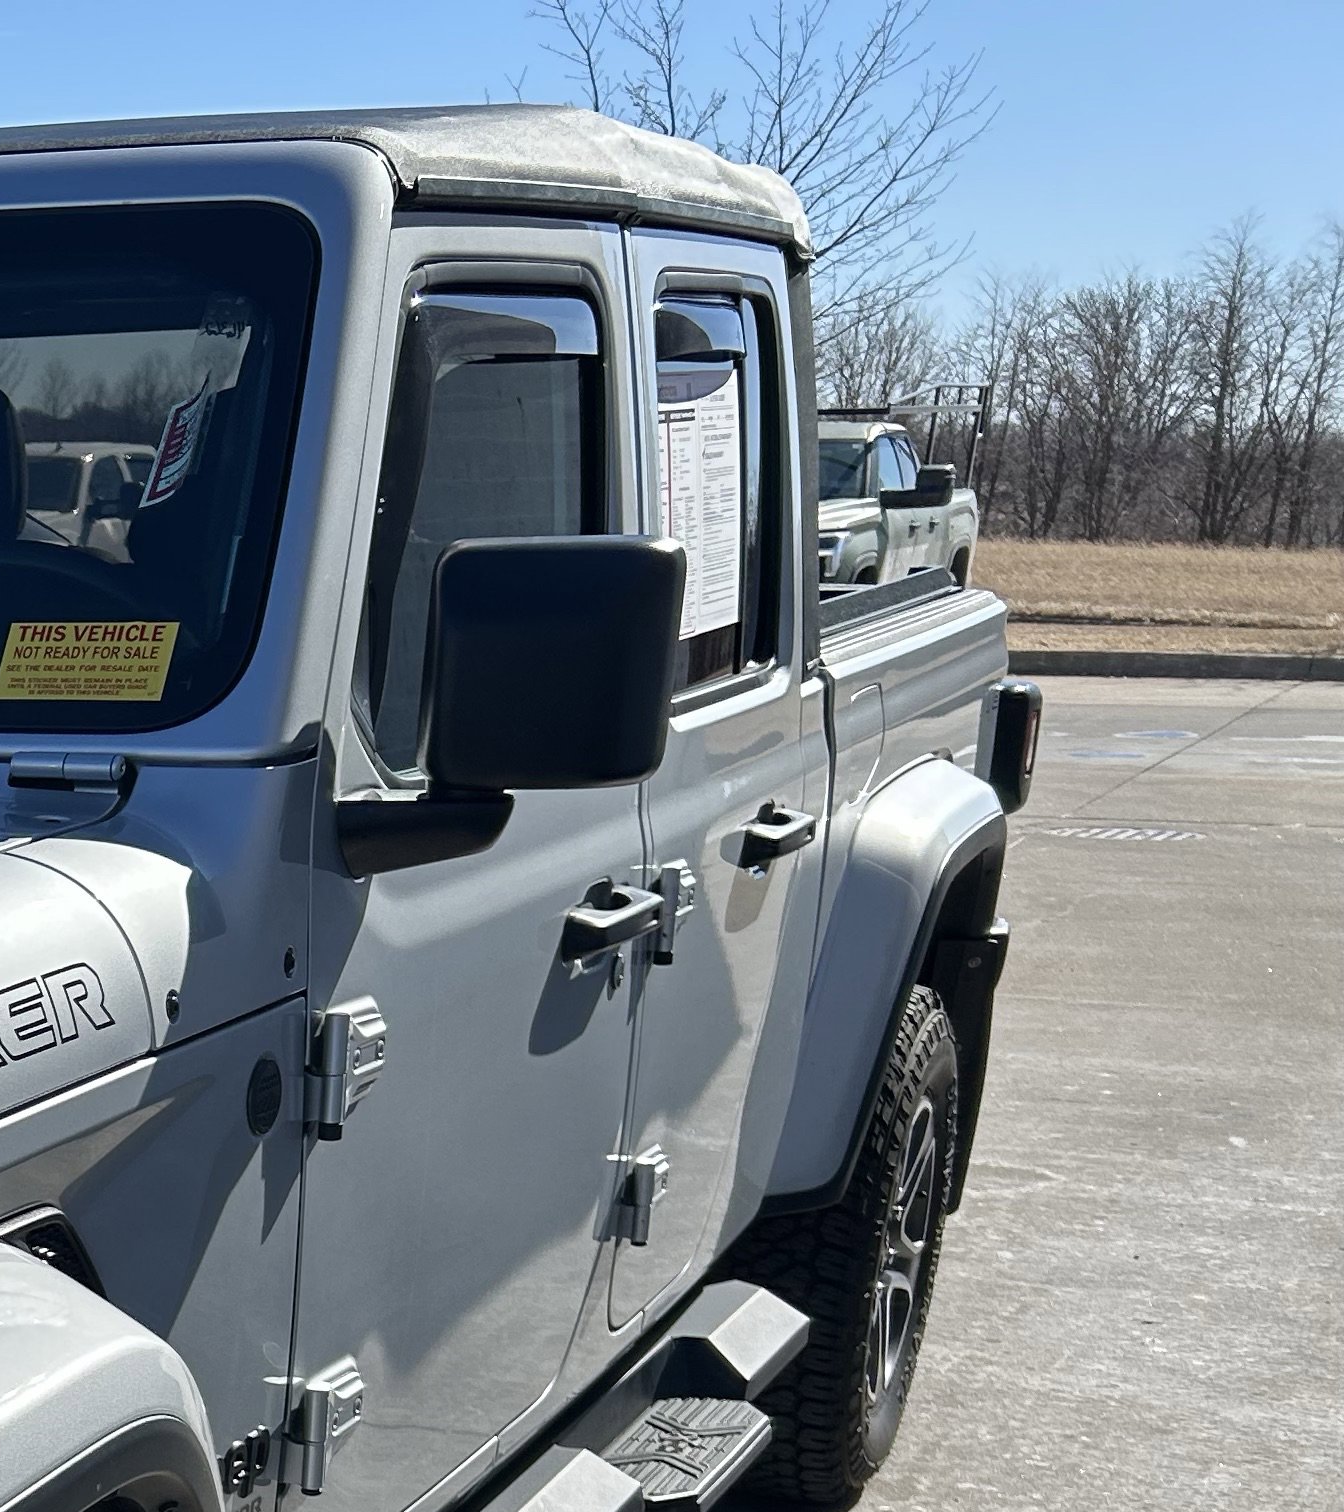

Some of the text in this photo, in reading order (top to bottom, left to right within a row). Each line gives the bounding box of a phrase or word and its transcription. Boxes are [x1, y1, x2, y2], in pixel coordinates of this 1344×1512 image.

[18, 624, 167, 642] THIS VEHICLE
[13, 646, 160, 659] NOT READY FOR SALE
[5, 664, 160, 673] SEE THE DEALER FOR RESALE DATE
